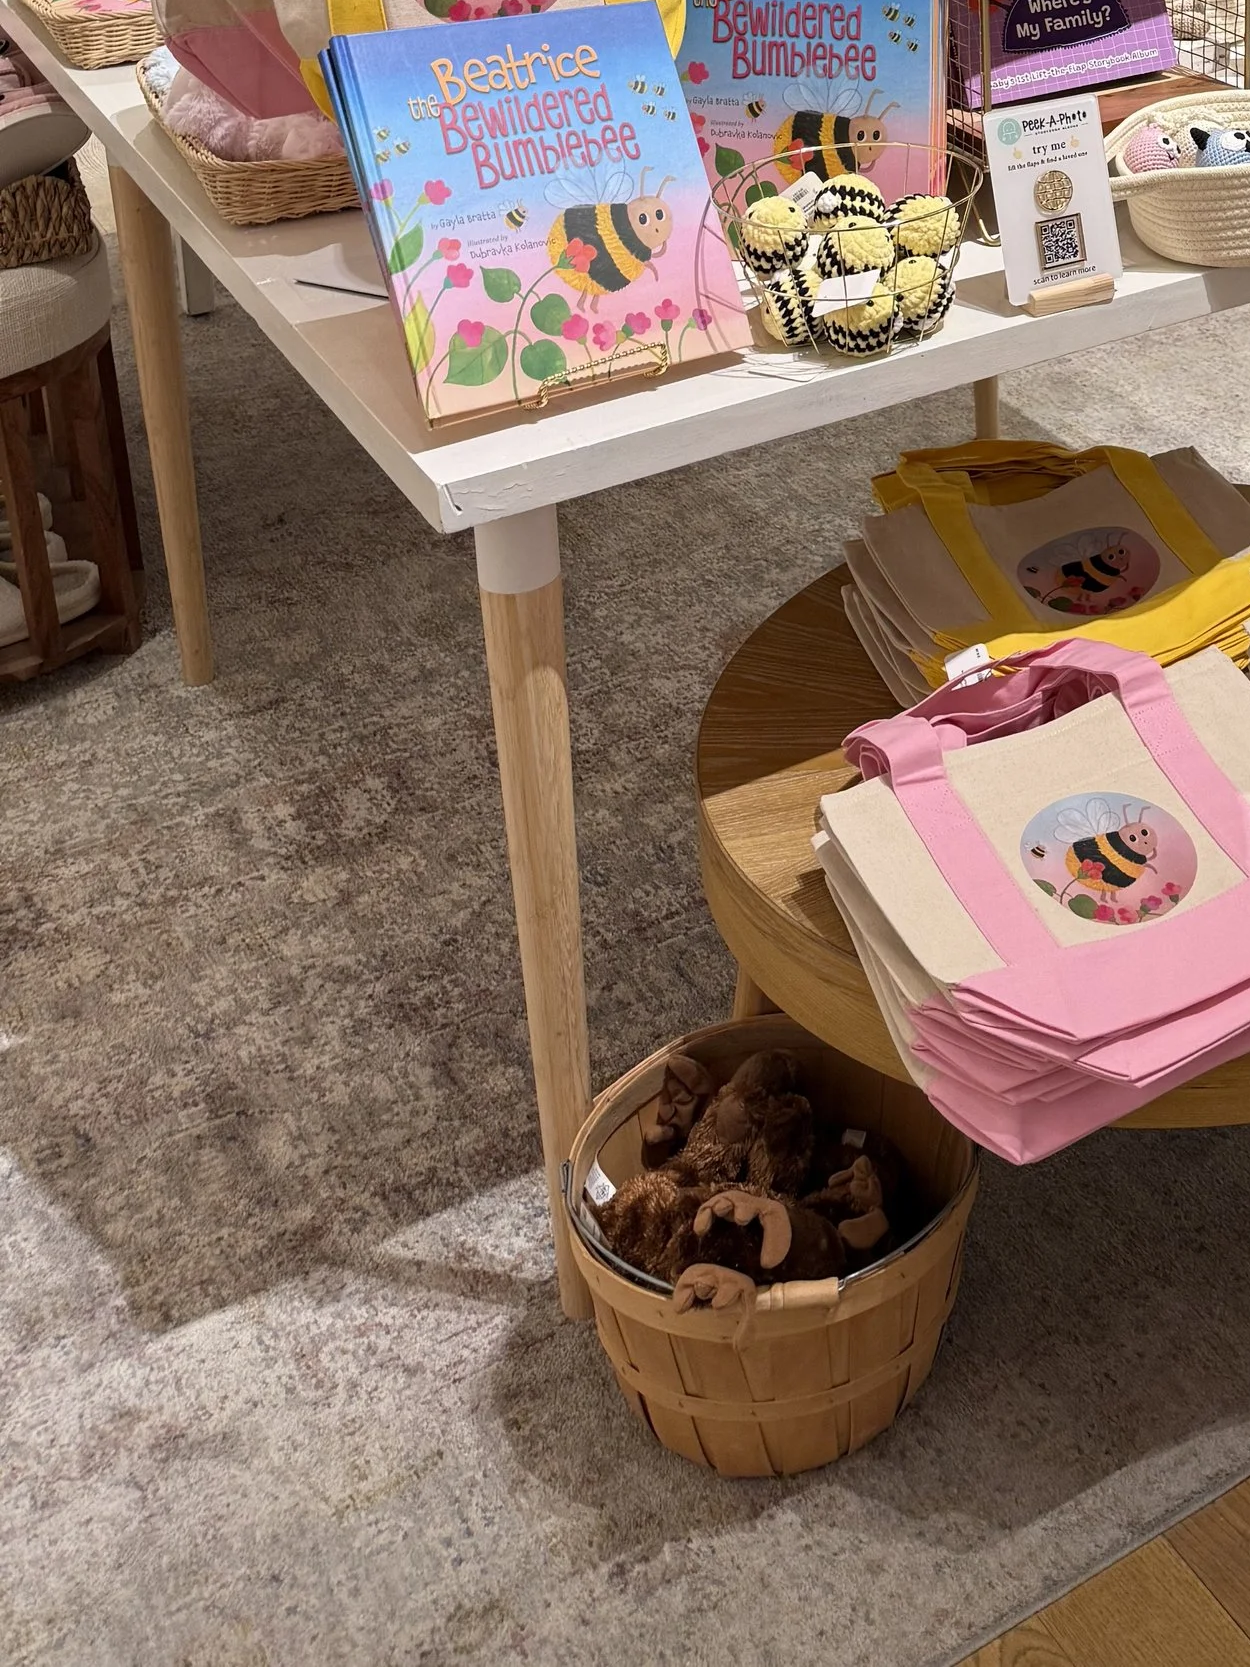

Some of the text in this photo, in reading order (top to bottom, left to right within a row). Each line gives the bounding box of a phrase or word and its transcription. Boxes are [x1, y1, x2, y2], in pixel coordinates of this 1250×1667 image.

[1016, 5, 1111, 40] My Family?
[732, 35, 878, 81] Bumblebee
[430, 43, 601, 107] Beatrice
[990, 77, 1015, 89] aby's
[1016, 73, 1030, 84] 1st
[1088, 55, 1130, 70] Storybook
[1131, 49, 1158, 60] Album
[408, 93, 440, 121] the
[692, 96, 714, 108] Gayla
[716, 97, 740, 106] Bratta
[438, 84, 613, 155] Bewildered
[710, 129, 746, 141] Dubravka
[471, 121, 641, 190] Bumblebee
[1032, 141, 1066, 156] try me
[1062, 152, 1077, 160] loved
[439, 215, 465, 230] Gayla
[467, 211, 497, 223] Bratta
[500, 234, 508, 242] by
[470, 244, 513, 259] Dubravka
[1033, 265, 1096, 285] scan to learn more
